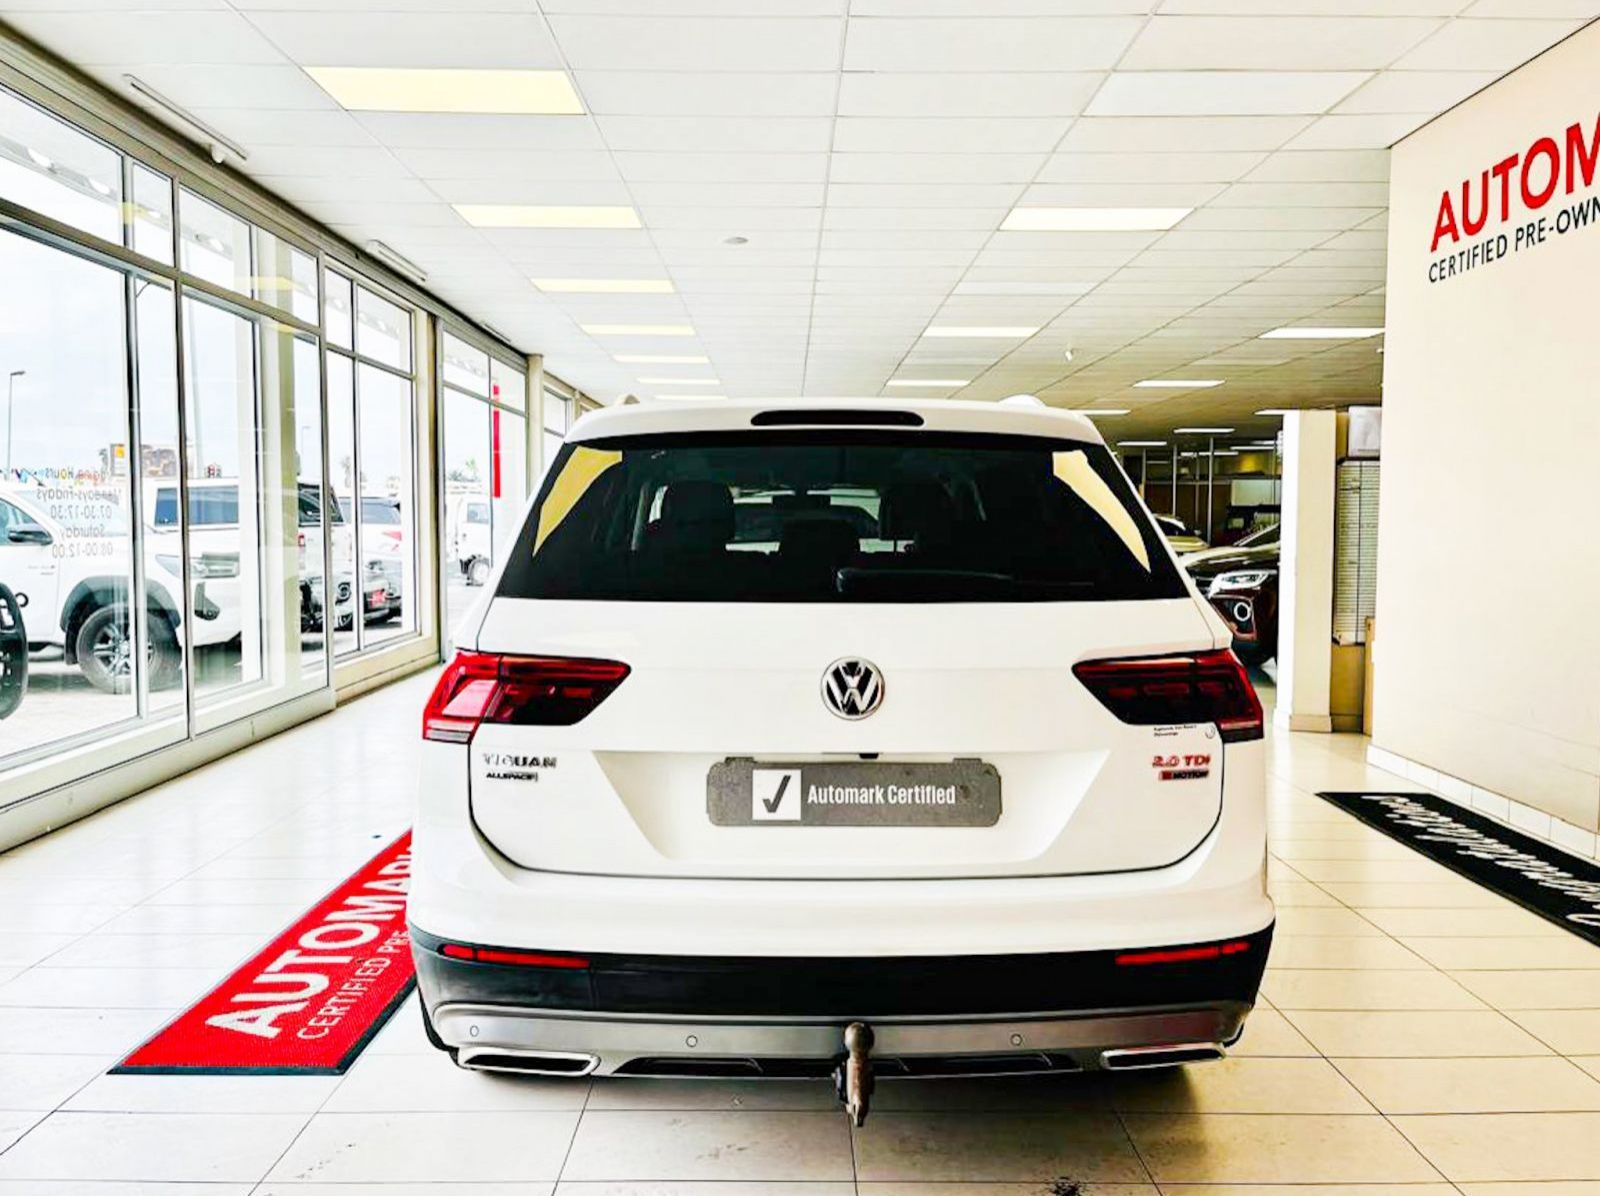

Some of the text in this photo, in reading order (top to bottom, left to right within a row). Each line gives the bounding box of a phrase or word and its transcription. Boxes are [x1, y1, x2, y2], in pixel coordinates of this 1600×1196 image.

[1430, 111, 1600, 252] AUTOM
[1428, 234, 1508, 283] CERTIFIED
[1183, 754, 1211, 767] TDI
[807, 785, 956, 804] Automark Certified
[297, 957, 392, 1040] CERTIFIED
